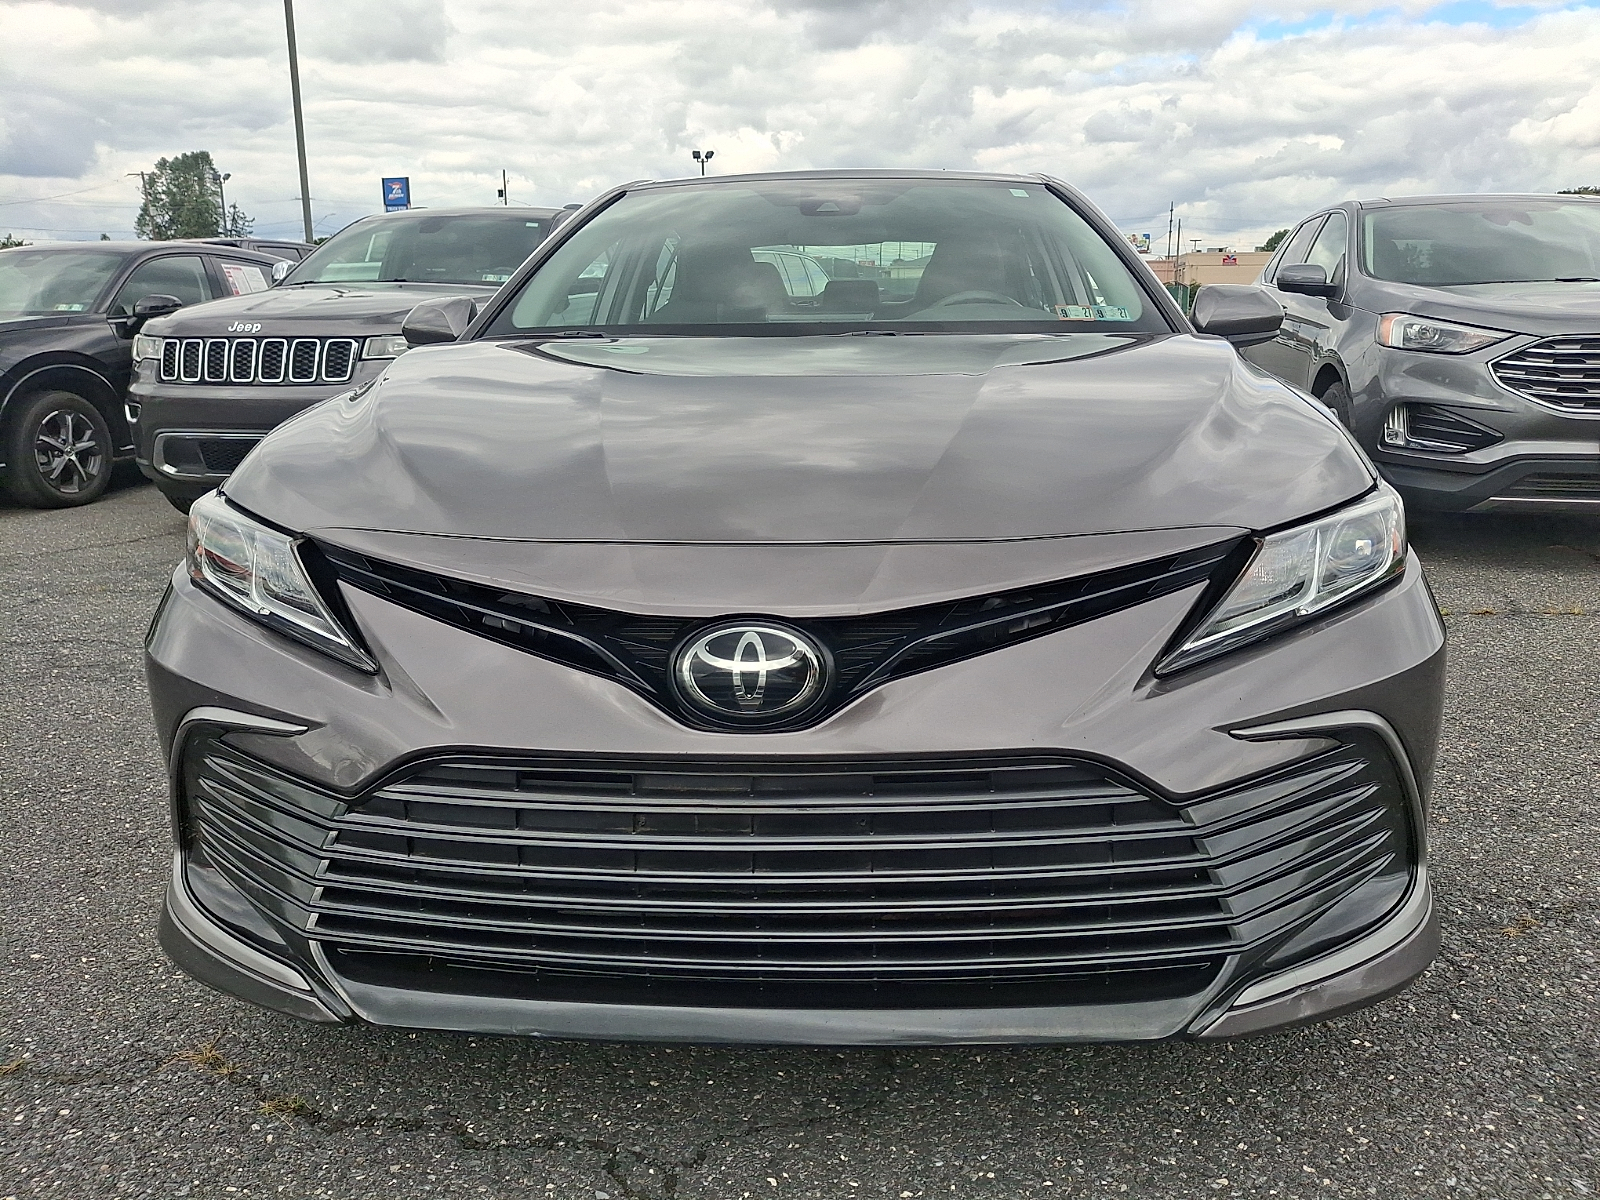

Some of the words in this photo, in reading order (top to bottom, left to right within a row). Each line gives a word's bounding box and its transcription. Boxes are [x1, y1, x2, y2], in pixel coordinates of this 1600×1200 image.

[1060, 308, 1069, 318] 9
[1082, 307, 1092, 318] 27
[1096, 309, 1105, 319] 9
[1117, 307, 1128, 319] 27
[227, 321, 262, 334] Jeep
